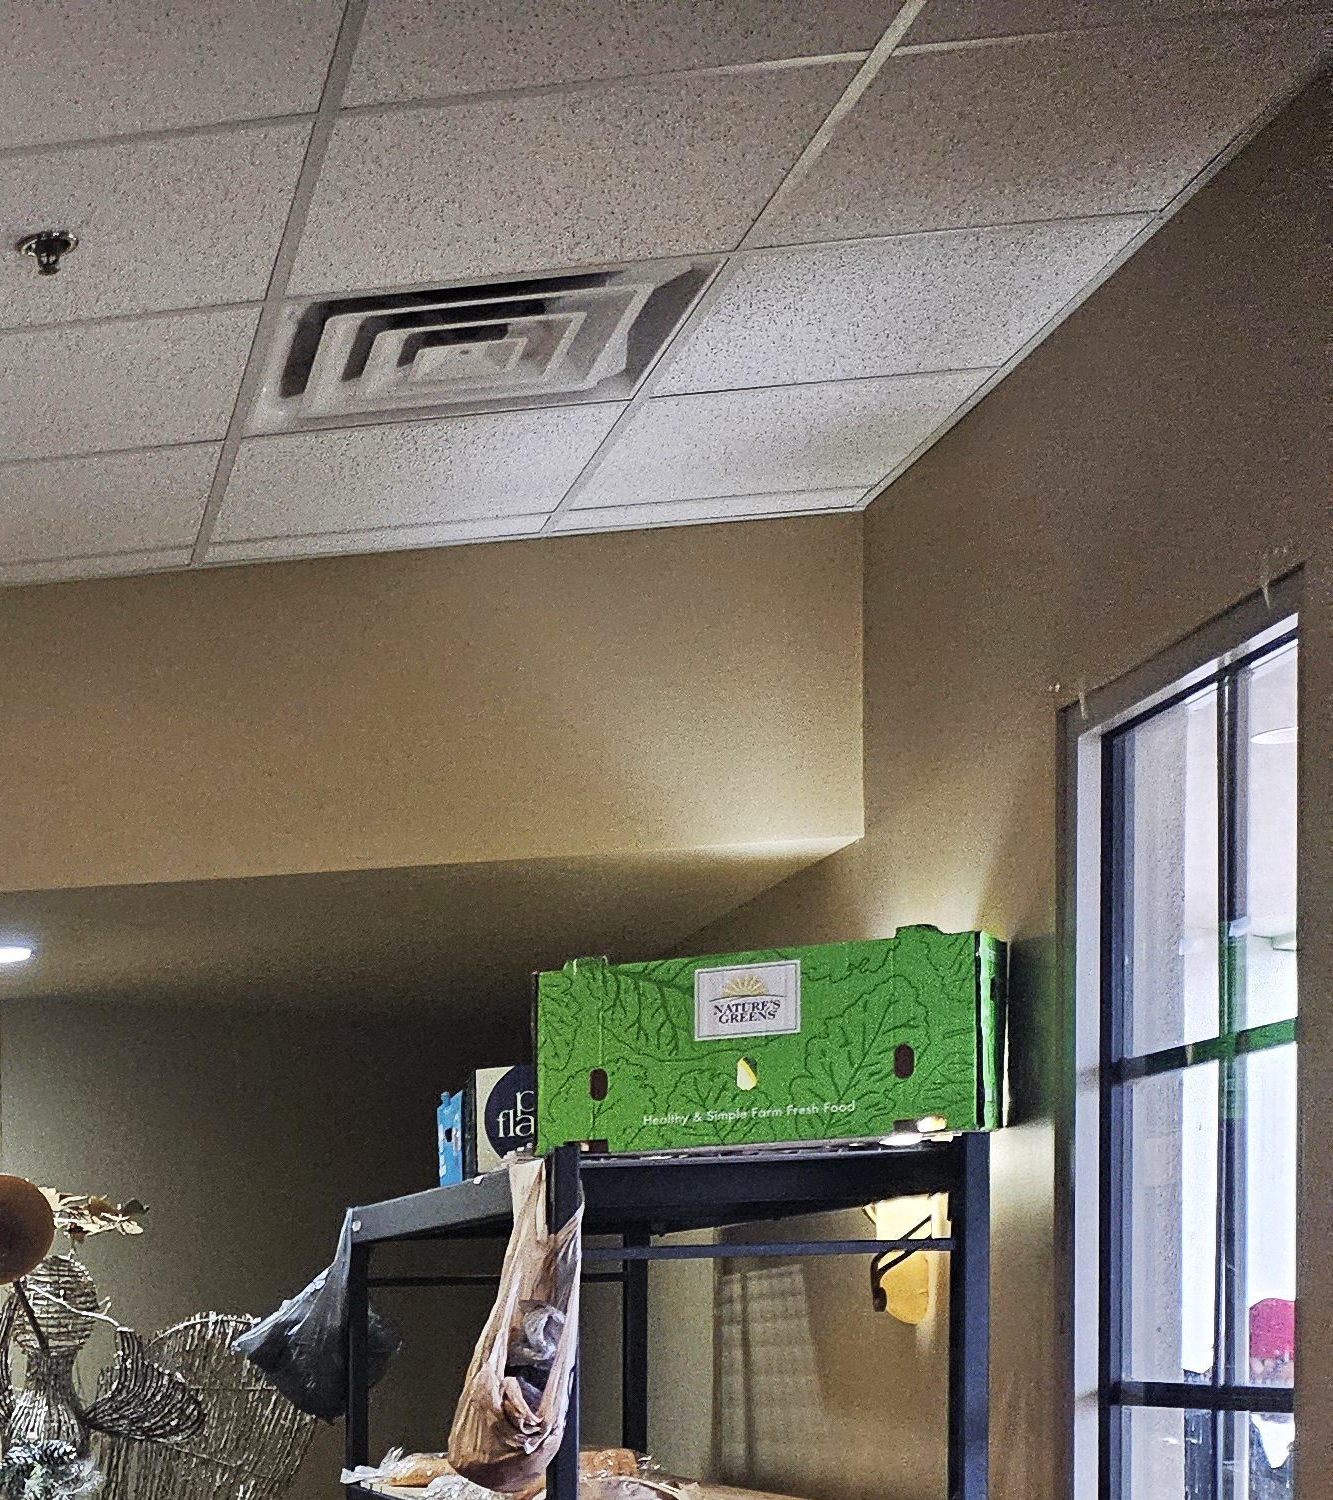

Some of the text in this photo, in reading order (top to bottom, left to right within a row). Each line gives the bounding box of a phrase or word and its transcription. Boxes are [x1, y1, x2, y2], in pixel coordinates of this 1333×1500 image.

[714, 999, 781, 1015] NATURE'S
[718, 1009, 777, 1024] GREENS
[642, 1099, 856, 1125] Healthy & Simple Farm Fresh Food
